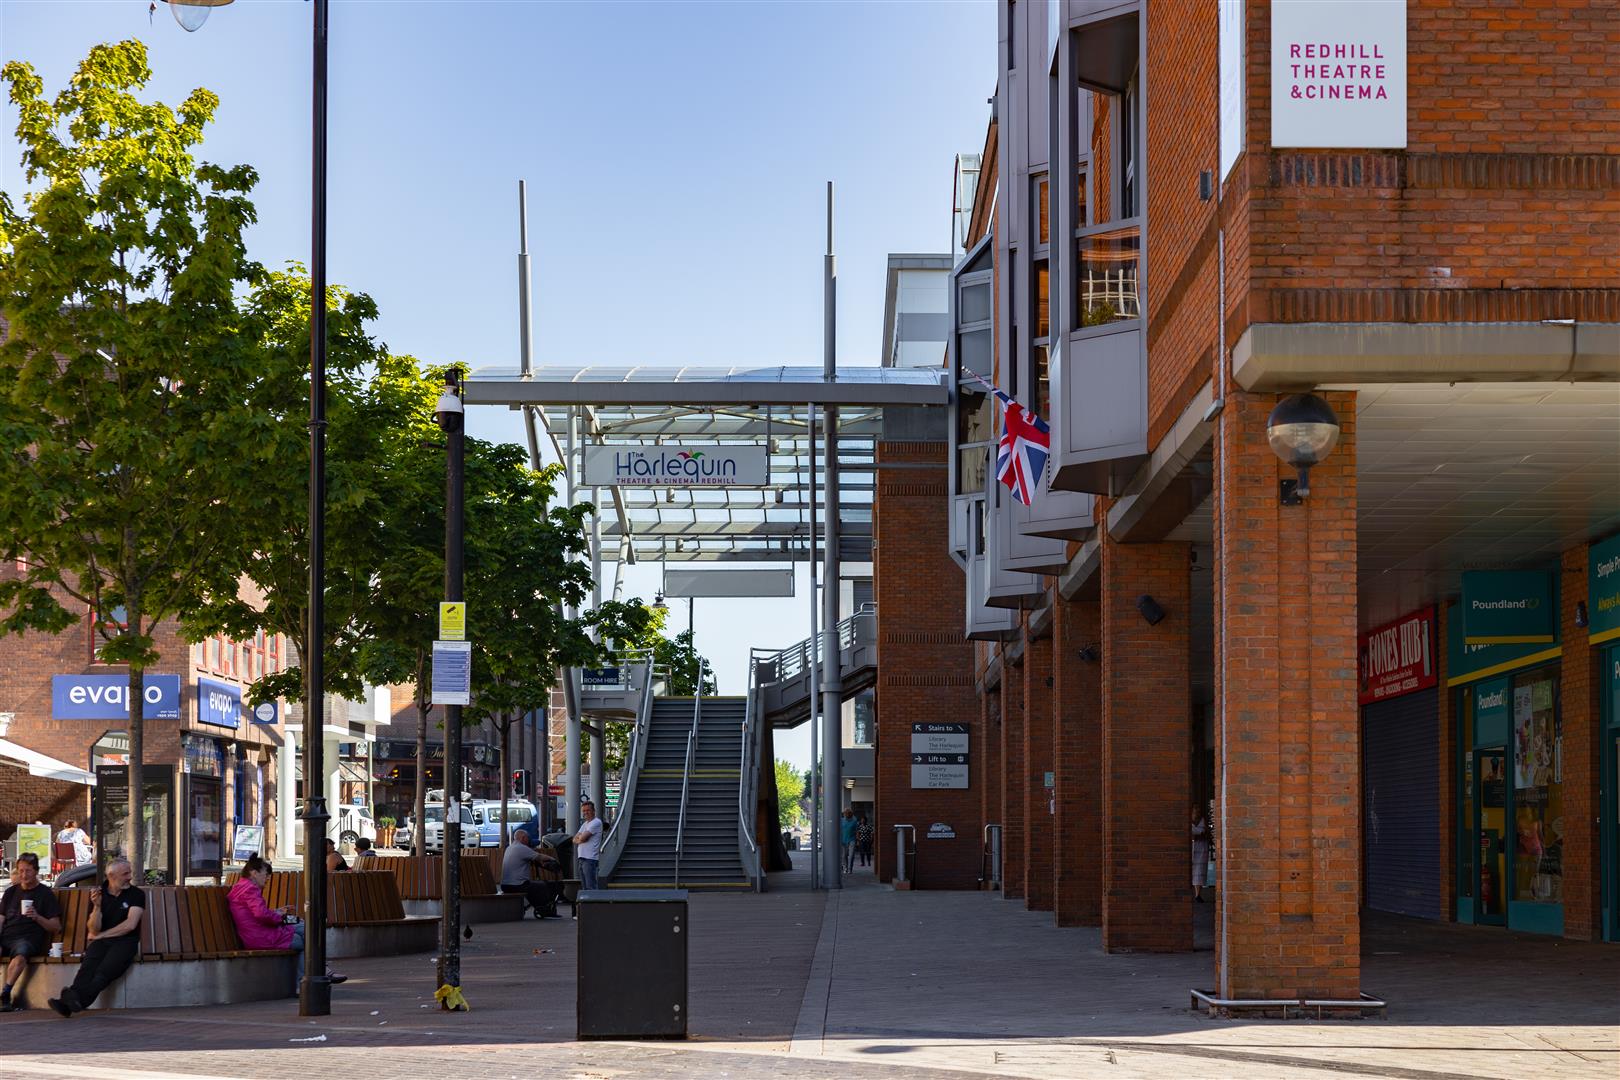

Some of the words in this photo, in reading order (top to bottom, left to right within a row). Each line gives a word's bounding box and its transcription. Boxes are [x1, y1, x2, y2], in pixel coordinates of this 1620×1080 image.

[1290, 44, 1384, 58] REDHILL
[1290, 64, 1386, 79] THEATRE
[1290, 84, 1388, 100] &CINEMA
[616, 451, 736, 483] Harlequin
[1472, 600, 1526, 610] Poundland
[1368, 626, 1399, 678] FONES
[1399, 618, 1421, 668] HUB
[209, 691, 232, 720] evapo
